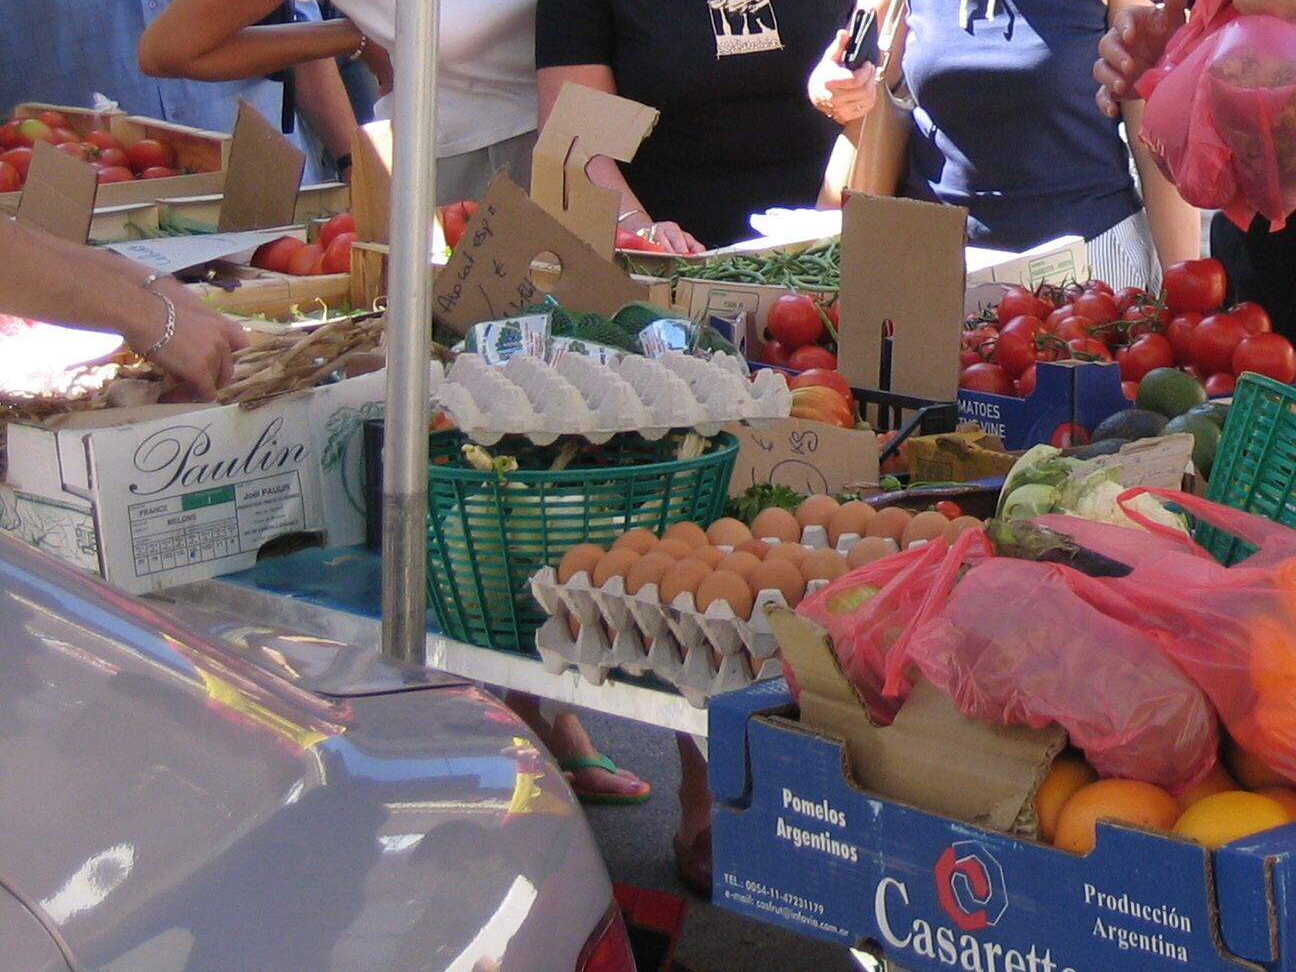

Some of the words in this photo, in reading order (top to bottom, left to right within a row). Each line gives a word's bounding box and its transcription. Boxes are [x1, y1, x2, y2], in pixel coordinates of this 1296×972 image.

[129, 417, 309, 495] Paulin
[139, 505, 168, 517] FRANCE
[167, 513, 197, 526] MELONS
[782, 787, 847, 828] Pomelos
[776, 816, 859, 862] Argentinos
[874, 876, 1078, 972] Casarett
[1083, 883, 1193, 933] Producción
[1092, 916, 1189, 964] Argentina
